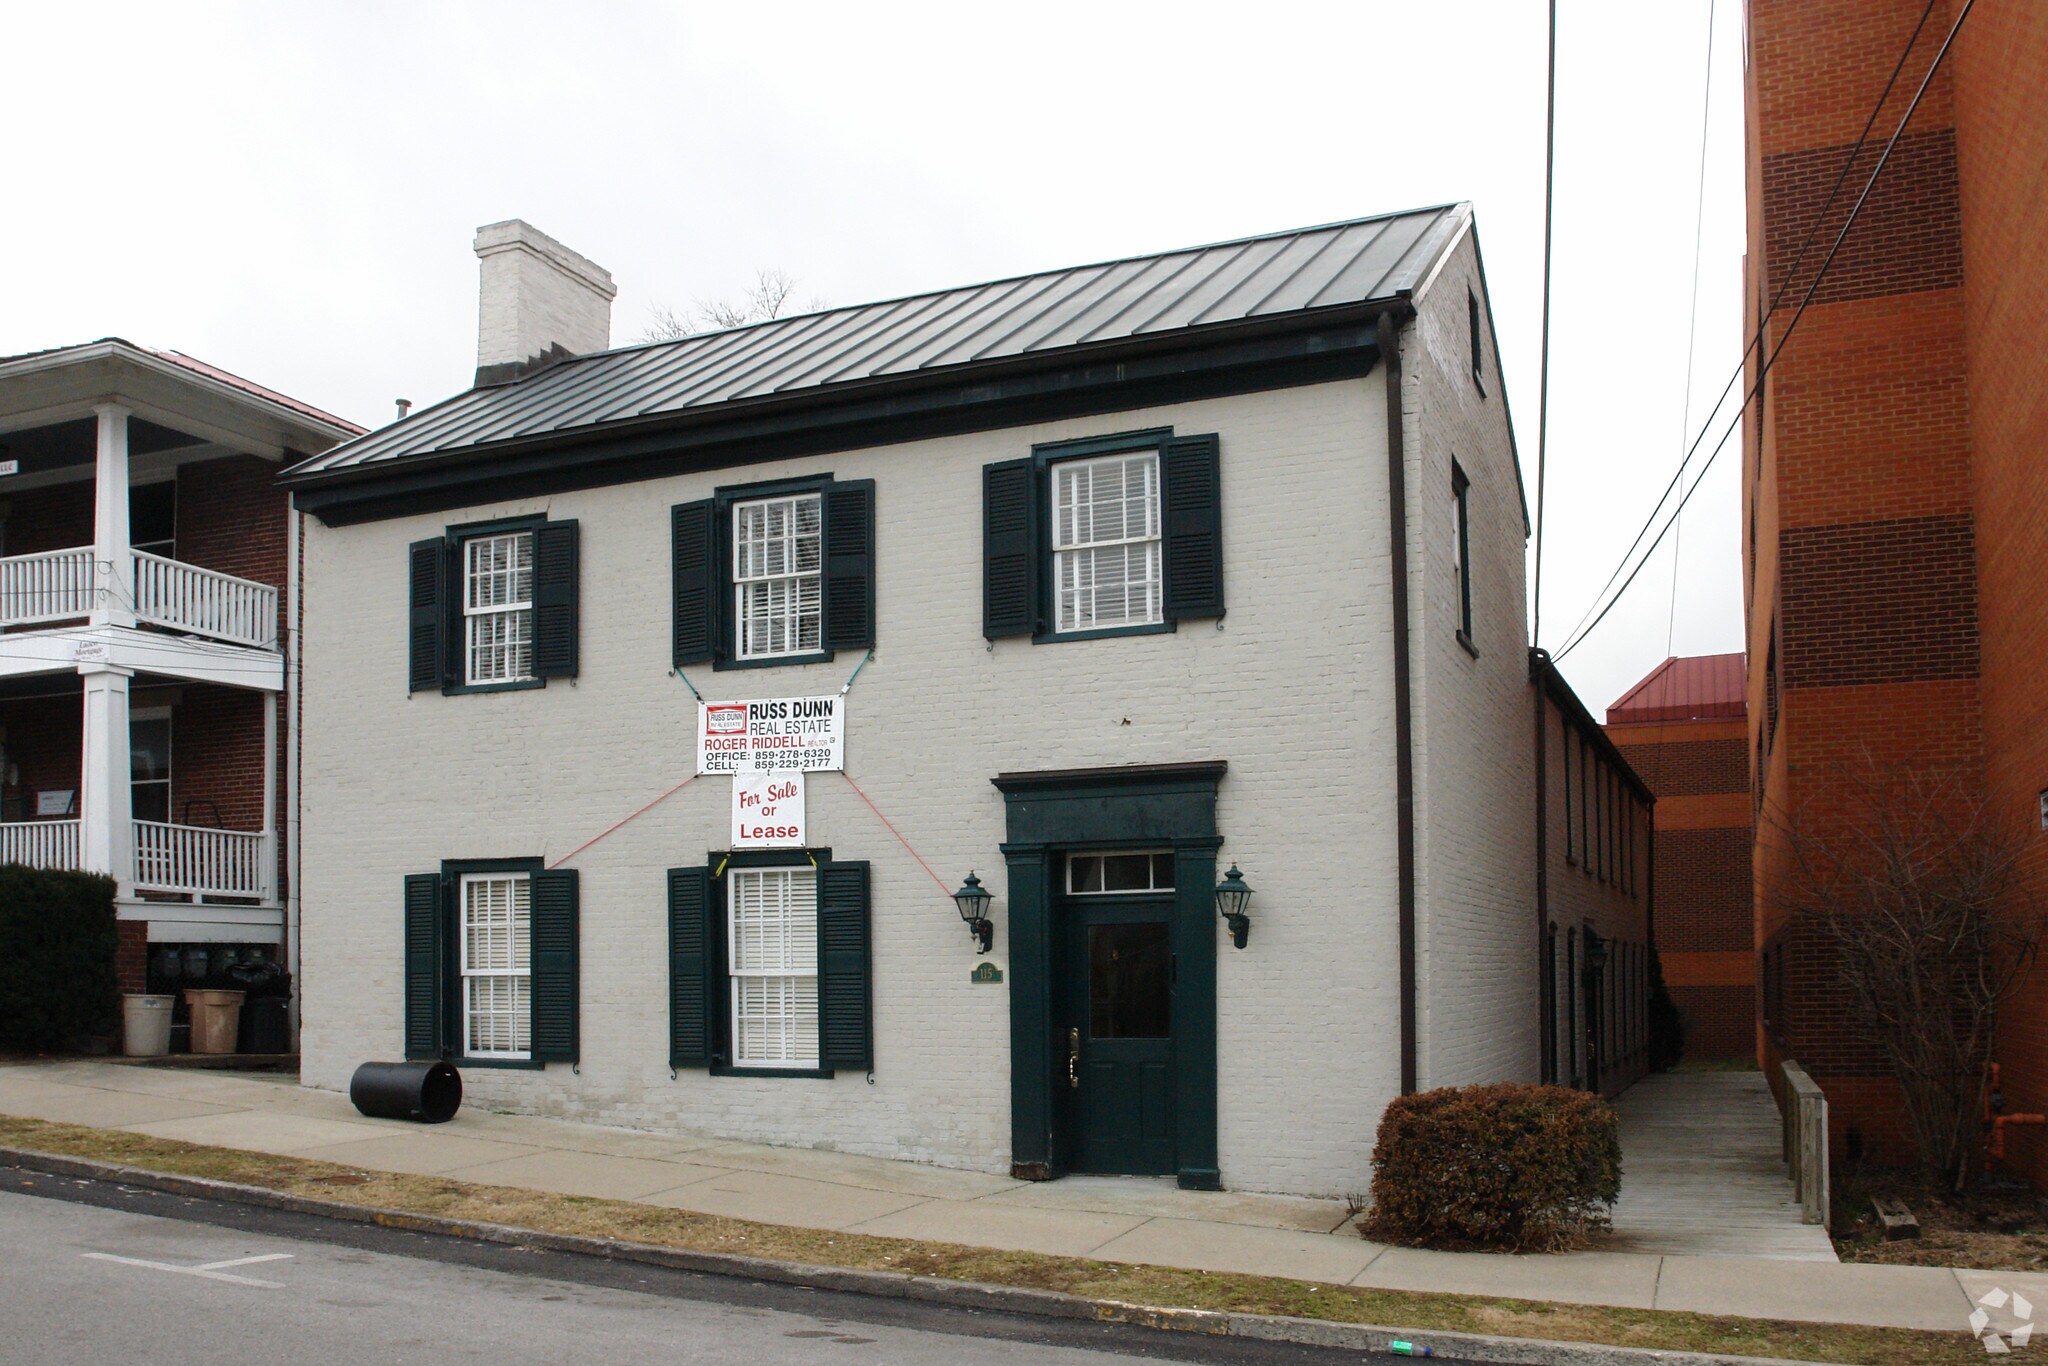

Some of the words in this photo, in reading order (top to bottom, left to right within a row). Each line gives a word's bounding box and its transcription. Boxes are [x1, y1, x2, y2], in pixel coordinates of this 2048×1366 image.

[710, 713, 726, 722] RUSS
[726, 712, 743, 721] DUNN
[749, 702, 788, 720] RUSS
[793, 700, 833, 718] DUNN
[750, 721, 781, 736] REAL
[785, 719, 831, 734] ESTATE
[704, 738, 747, 750] ROGER
[752, 736, 806, 749] RIDDELL
[706, 751, 751, 761] OFFICE:
[706, 761, 739, 770] CELL:
[739, 791, 761, 809] For
[767, 781, 798, 802] Sale
[761, 806, 777, 816] or
[740, 824, 799, 838] Lease
